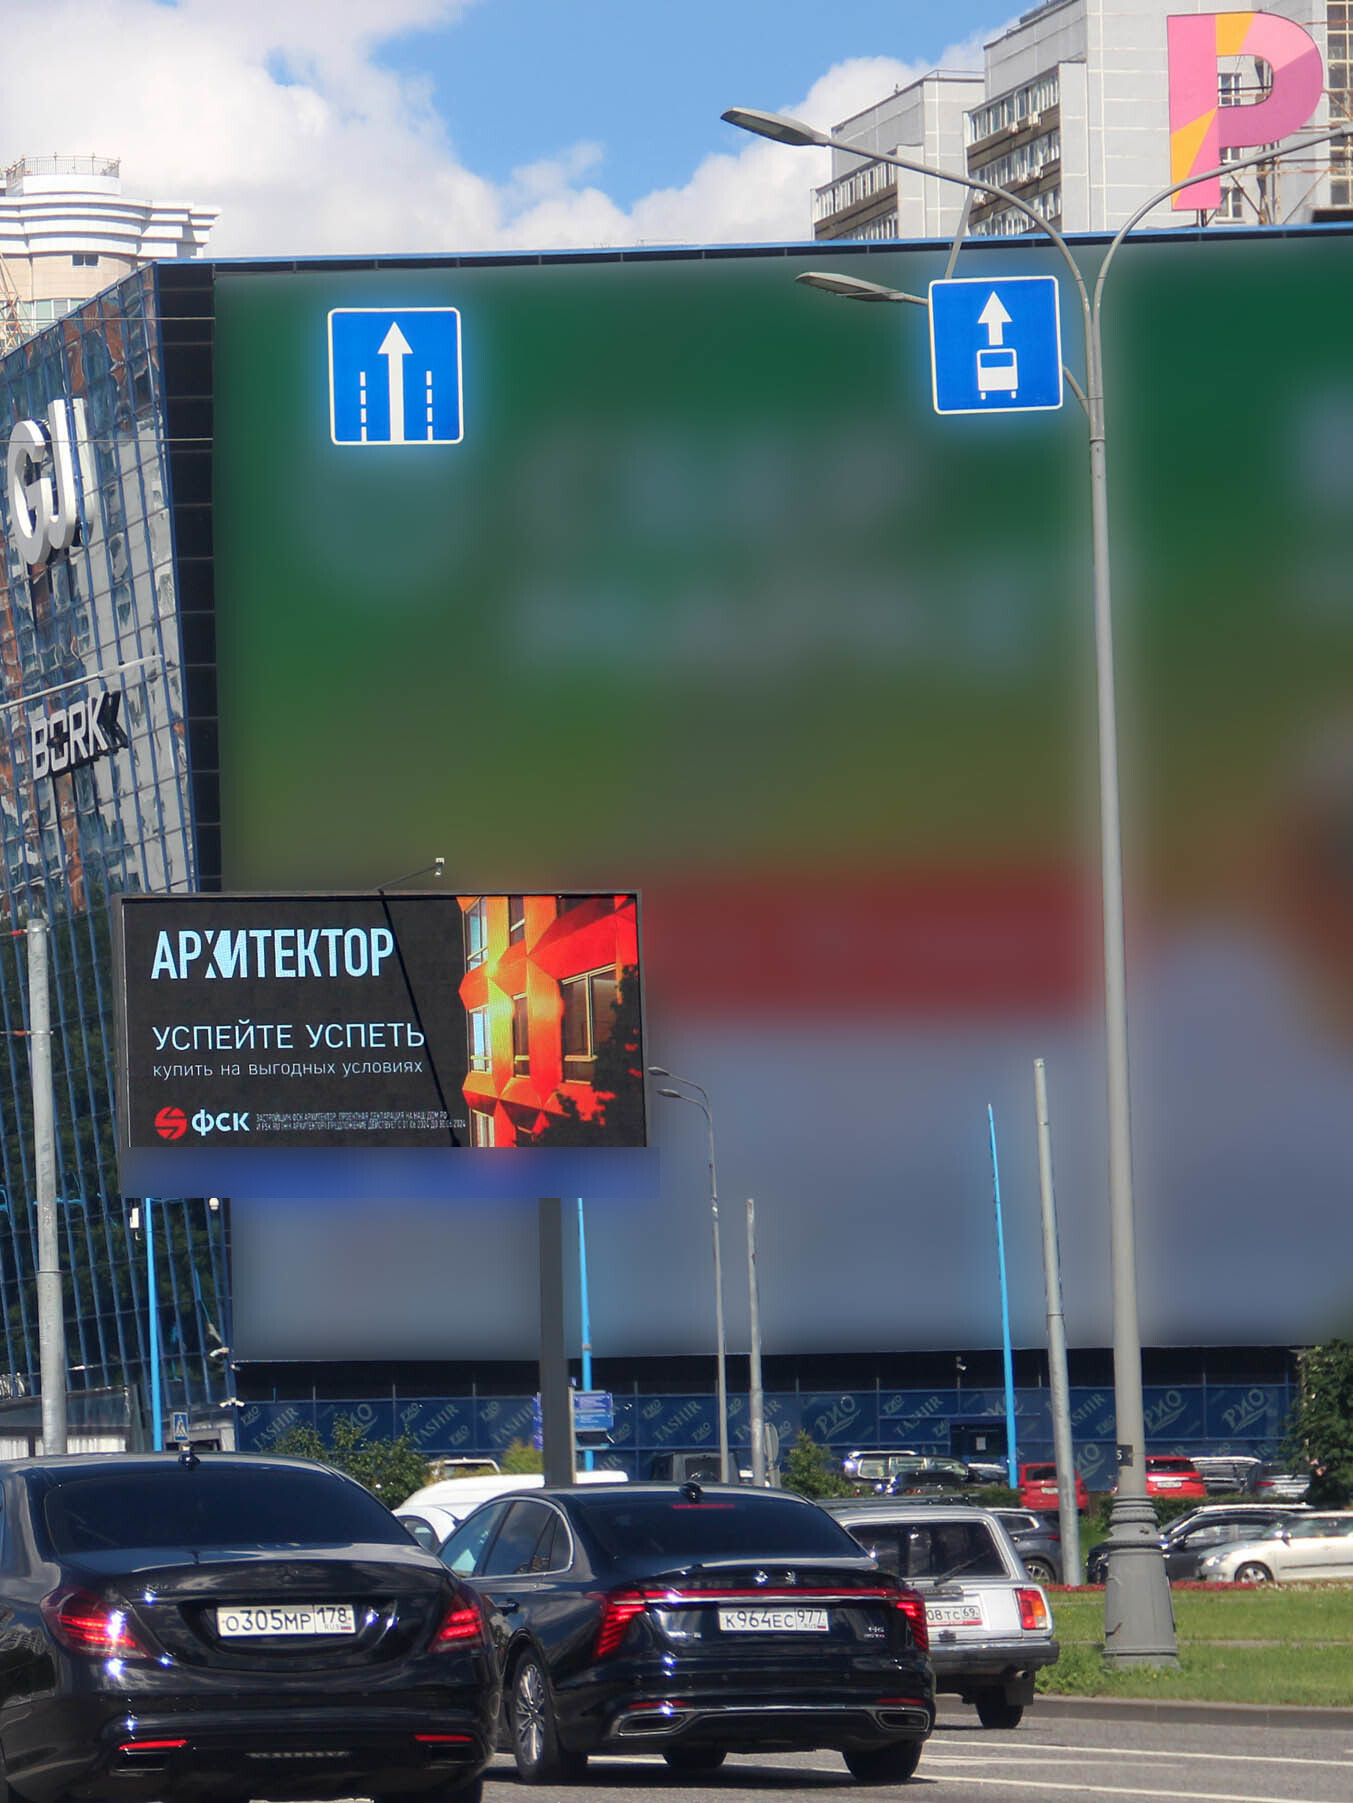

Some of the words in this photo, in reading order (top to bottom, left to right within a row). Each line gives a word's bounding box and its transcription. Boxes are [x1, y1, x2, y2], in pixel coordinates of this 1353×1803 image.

[31, 691, 108, 780] BORK
[151, 927, 394, 979] АРХИТЕКТОР
[152, 1019, 294, 1050] УСПЕЙТЕ
[305, 1023, 425, 1048] УСПЕТЬ
[153, 1064, 213, 1080] купить
[221, 1064, 240, 1076] на
[249, 1063, 336, 1077] выгодных
[342, 1061, 423, 1078] условиях
[653, 1401, 702, 1442] TASHIR
[815, 1396, 857, 1434] РИО
[1223, 1388, 1266, 1428] РИО
[316, 1607, 346, 1623] 178
[725, 1610, 794, 1628] К964ЕС
[797, 1609, 822, 1623] 977
